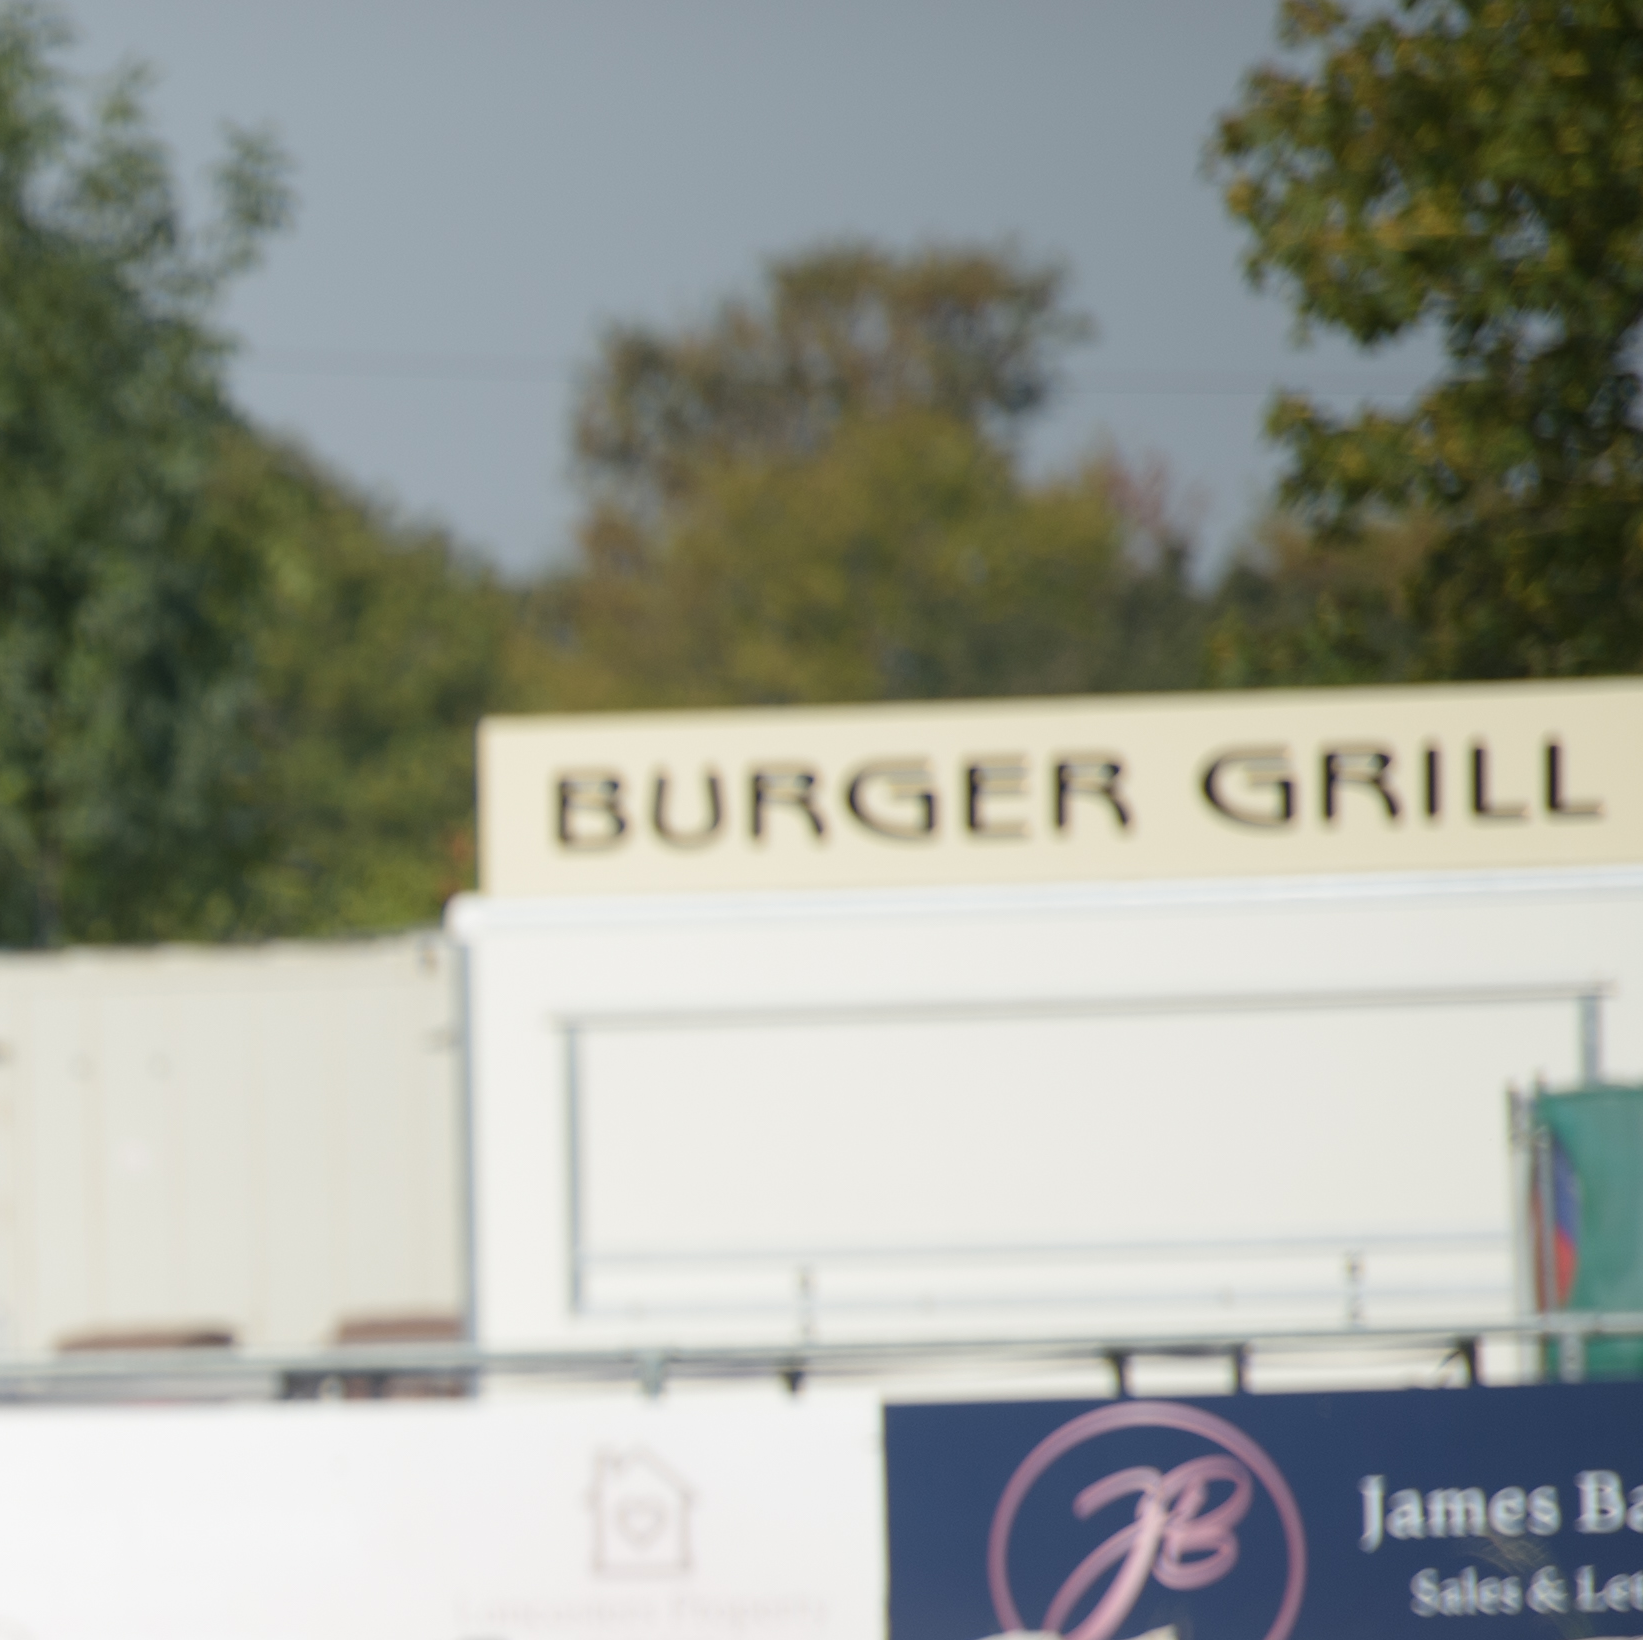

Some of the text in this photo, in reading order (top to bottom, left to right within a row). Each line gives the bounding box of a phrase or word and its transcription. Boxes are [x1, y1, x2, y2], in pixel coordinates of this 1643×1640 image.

[553, 731, 1607, 854] BURGER GRILL
[1357, 1474, 1562, 1553] James
[1409, 1565, 1524, 1618] Sales
[1526, 1564, 1569, 1615] &
